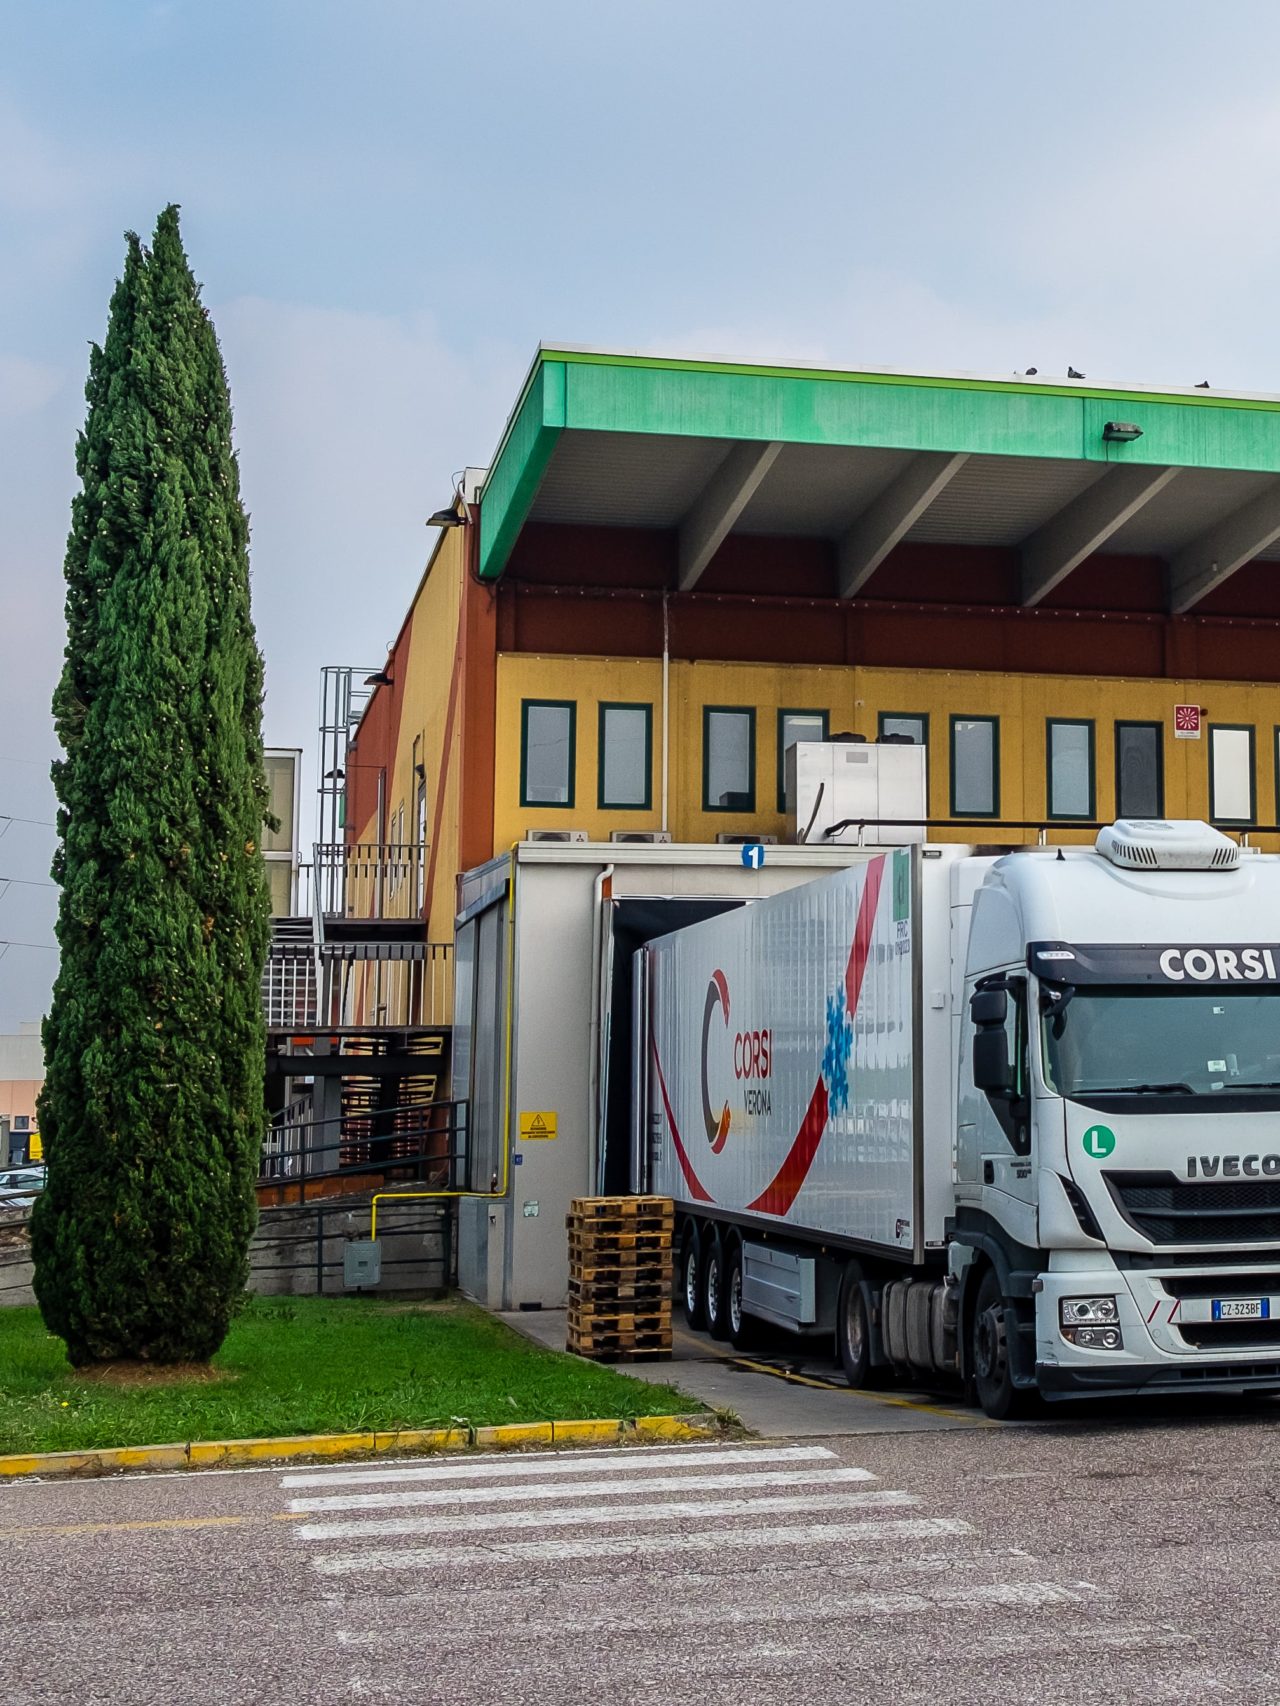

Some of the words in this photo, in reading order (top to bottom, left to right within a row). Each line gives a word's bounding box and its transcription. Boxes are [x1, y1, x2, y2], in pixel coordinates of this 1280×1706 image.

[748, 846, 759, 870] 1
[1159, 949, 1277, 981] CORSI
[734, 1028, 772, 1080] CORSI
[743, 1089, 772, 1116] VERONA
[1091, 1130, 1107, 1154] L
